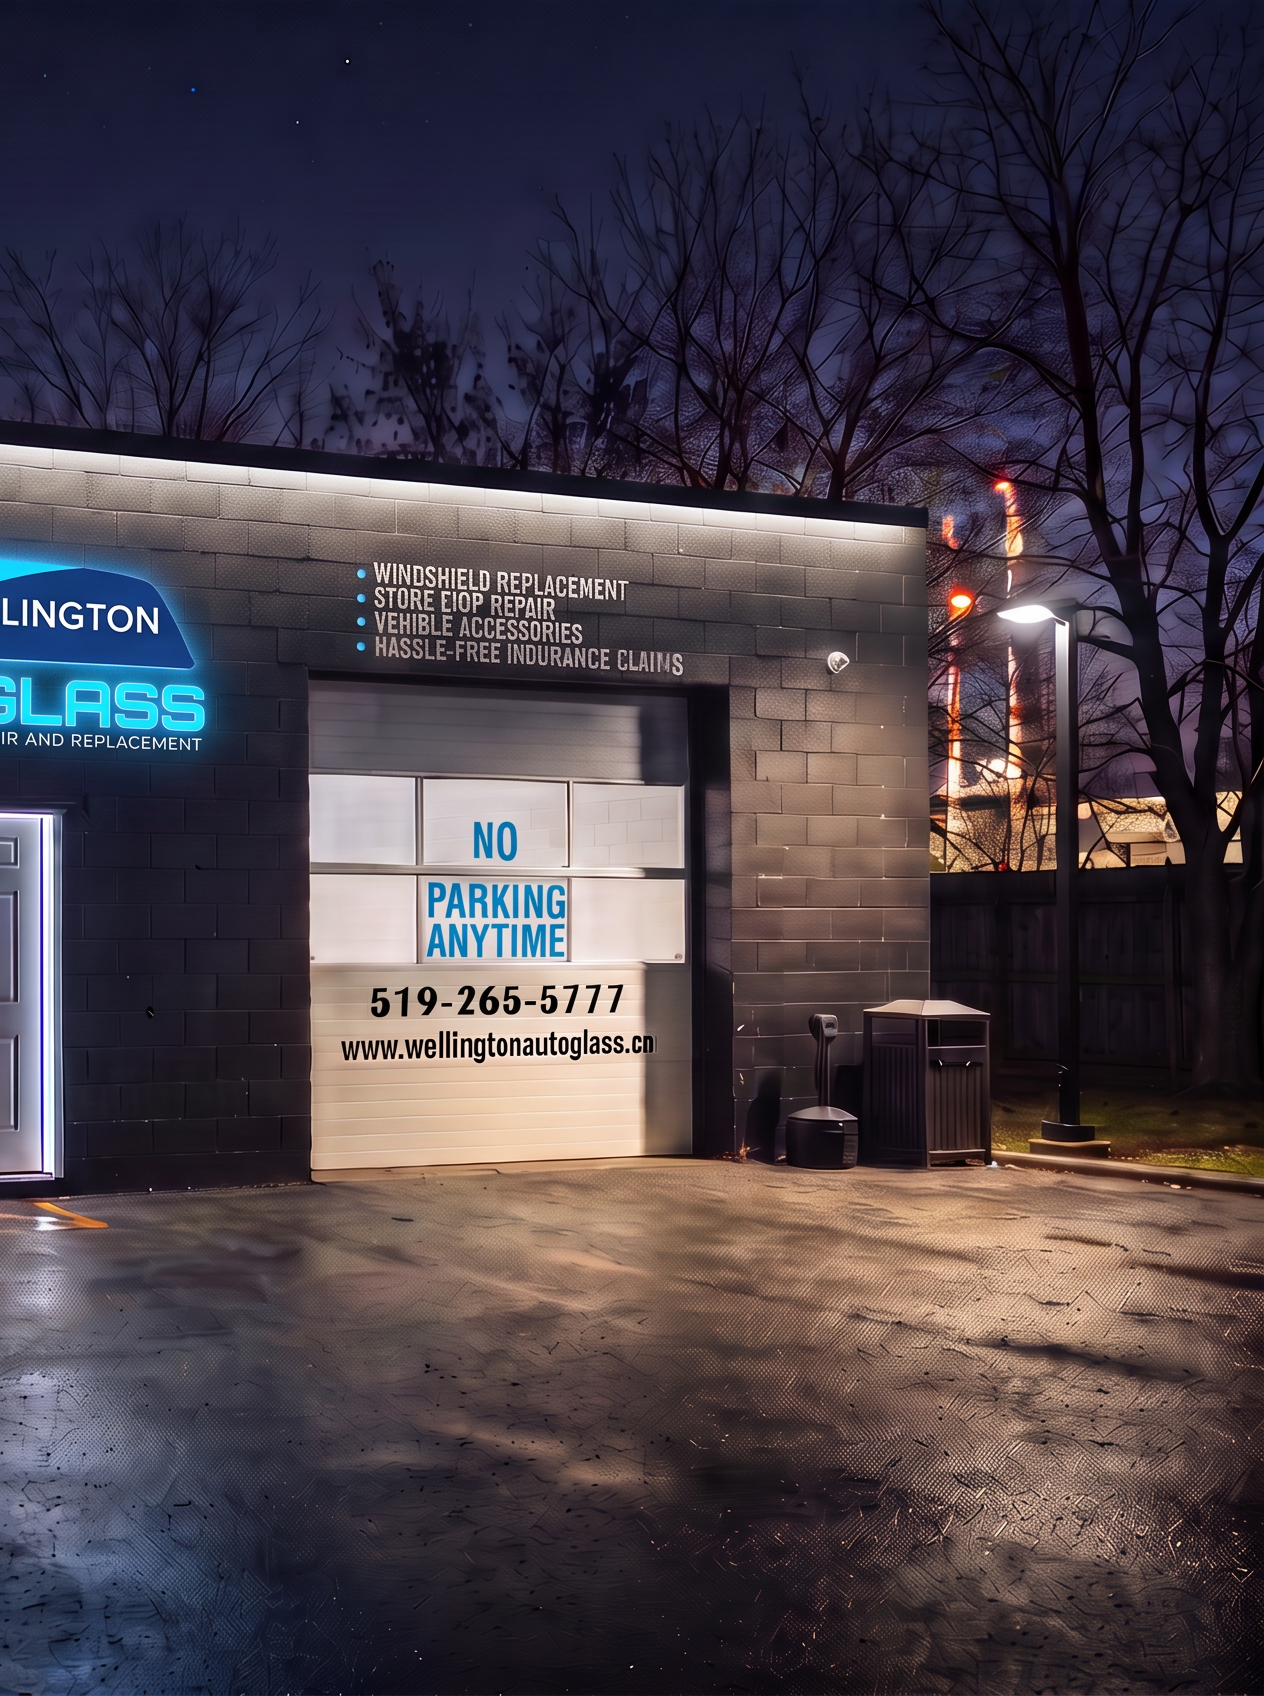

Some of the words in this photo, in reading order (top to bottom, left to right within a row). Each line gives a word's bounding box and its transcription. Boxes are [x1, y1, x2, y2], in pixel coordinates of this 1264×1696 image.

[373, 562, 491, 592] WINDSHIELD
[497, 571, 629, 601] REPLACEMENT
[374, 586, 435, 612] STORE
[490, 594, 556, 620] REPAIR
[374, 611, 454, 637] VEHIBLE
[459, 616, 583, 645] ACCESSORIES
[375, 636, 501, 664] HASSLE-FREE
[507, 643, 611, 670] INDURANCE
[24, 732, 64, 747] AND
[71, 734, 203, 751] REPLACEMENT
[473, 821, 518, 861] NO
[427, 881, 567, 919] PARKING
[426, 923, 566, 958] ANYTIME
[370, 984, 624, 1018] 519-265-5777
